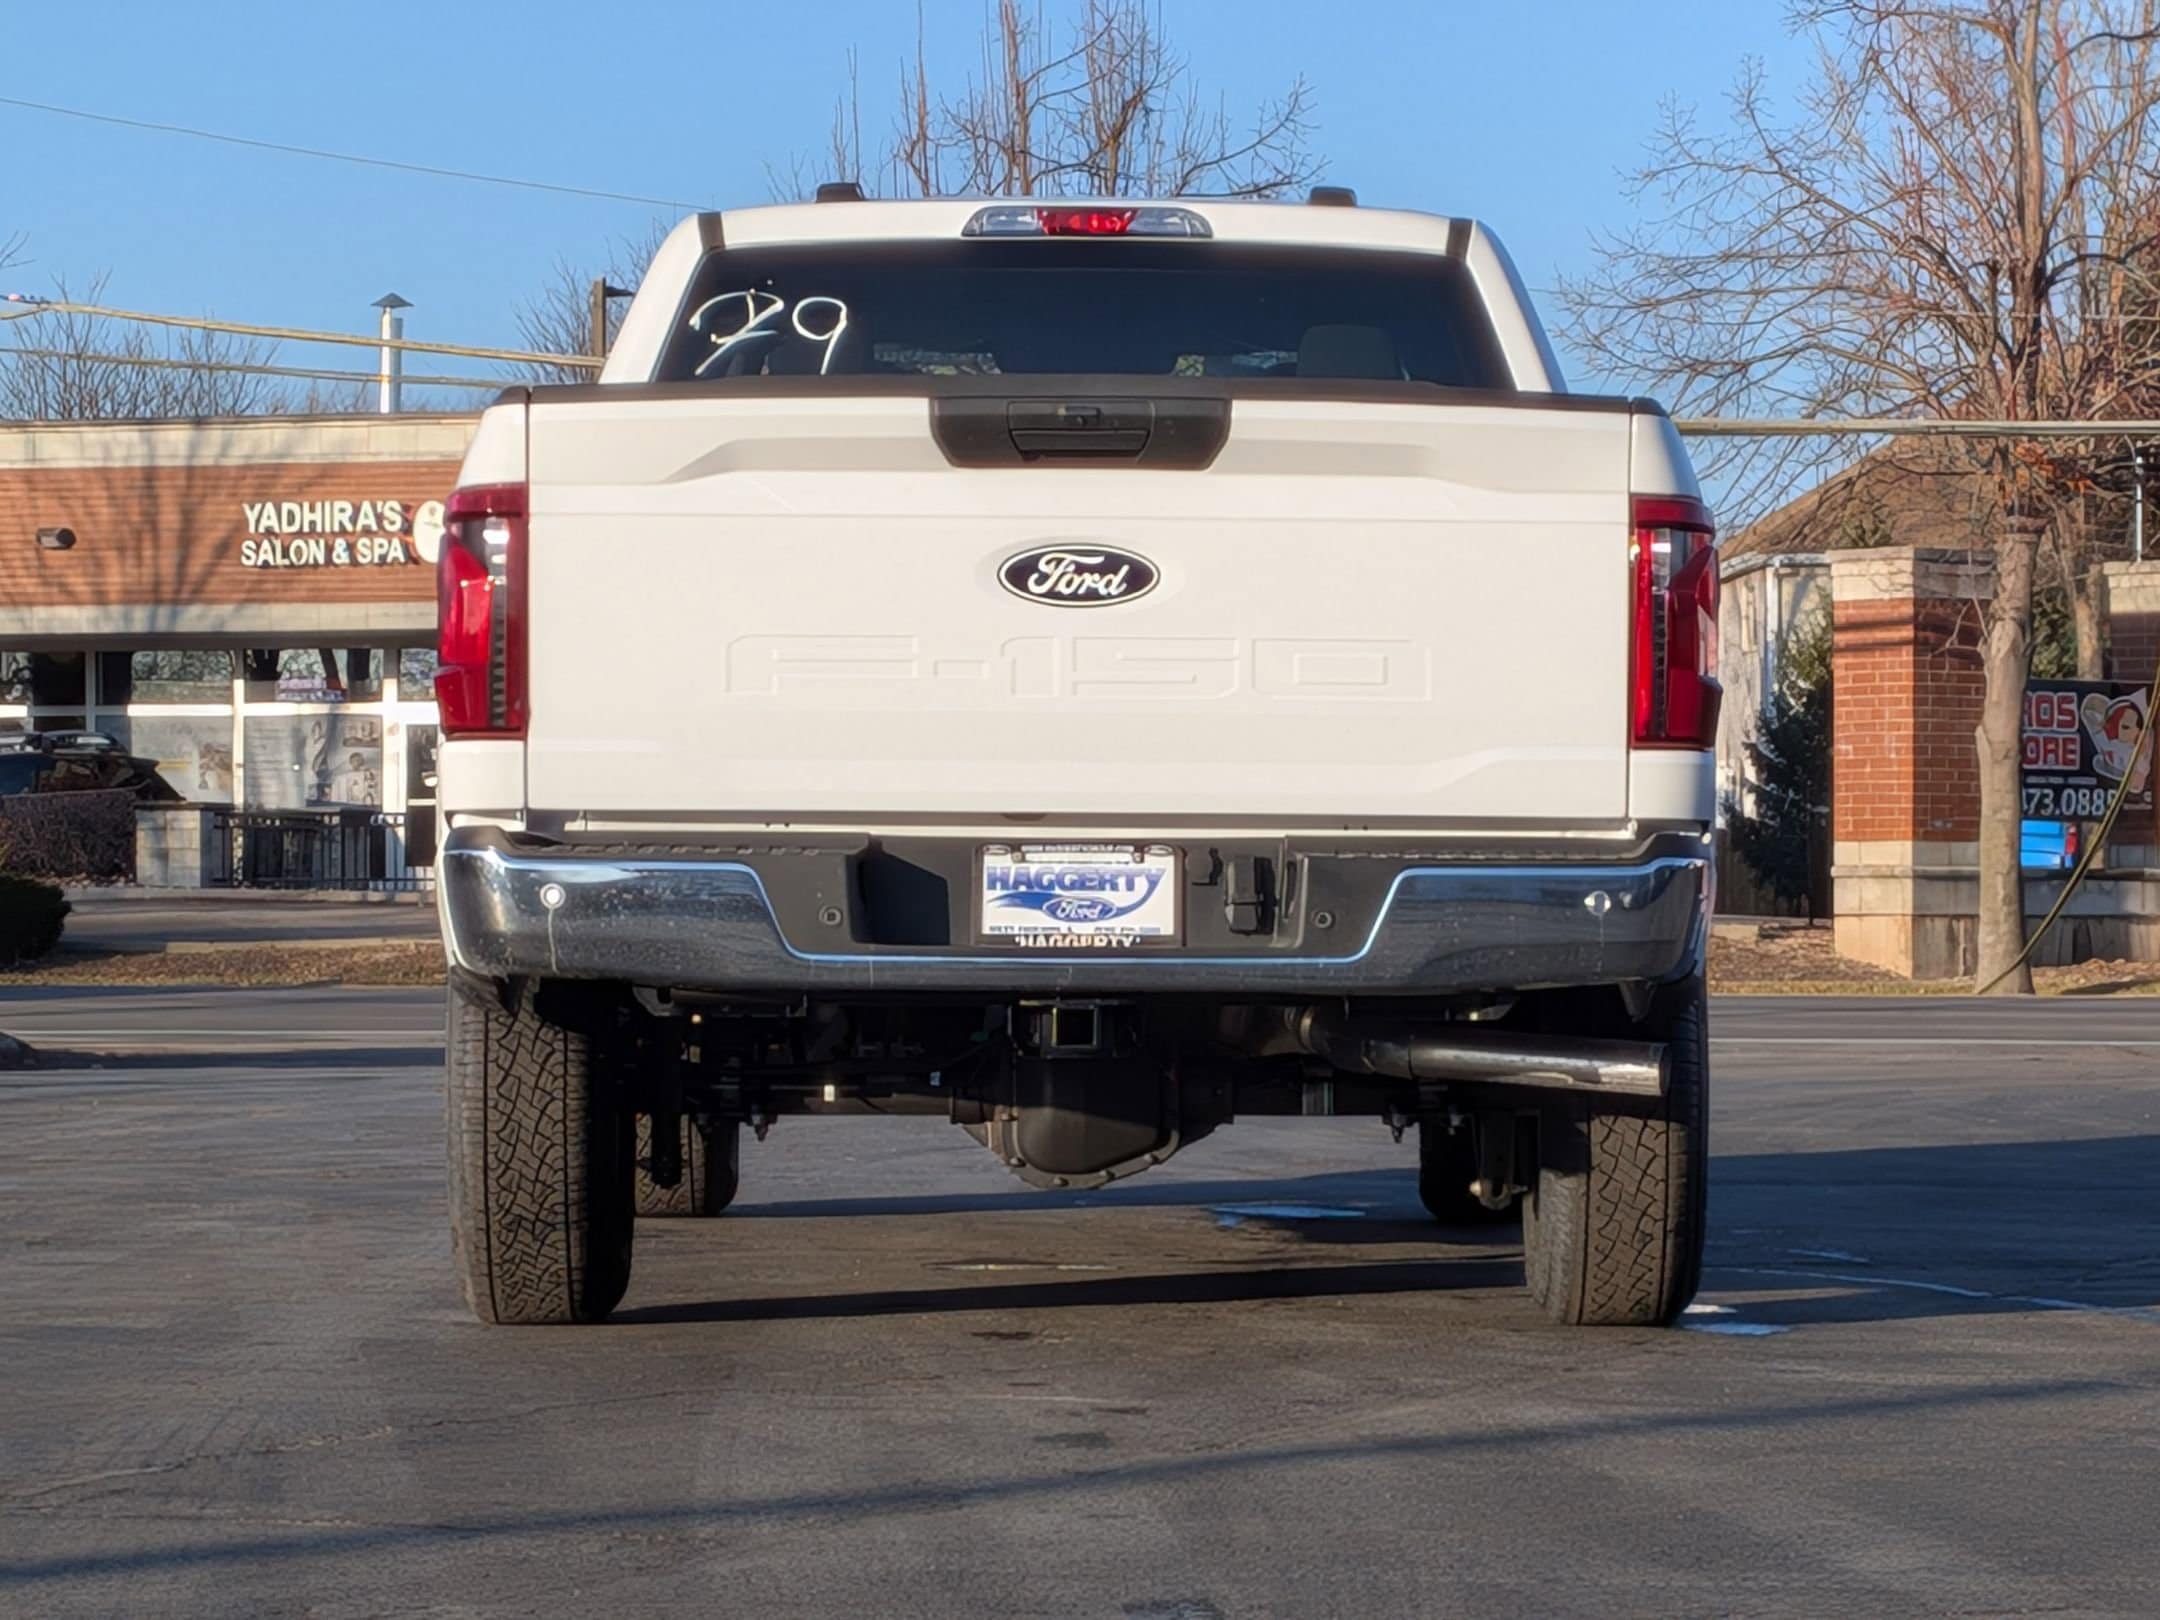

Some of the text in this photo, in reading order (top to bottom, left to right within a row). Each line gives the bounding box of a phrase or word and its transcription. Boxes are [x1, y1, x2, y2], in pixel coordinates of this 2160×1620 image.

[241, 500, 403, 534] YADHIRA'S
[240, 536, 406, 567] SALON & SPA
[1027, 552, 1128, 596] Ford
[725, 633, 1434, 702] F-150
[986, 866, 1167, 892] HAGGERTY
